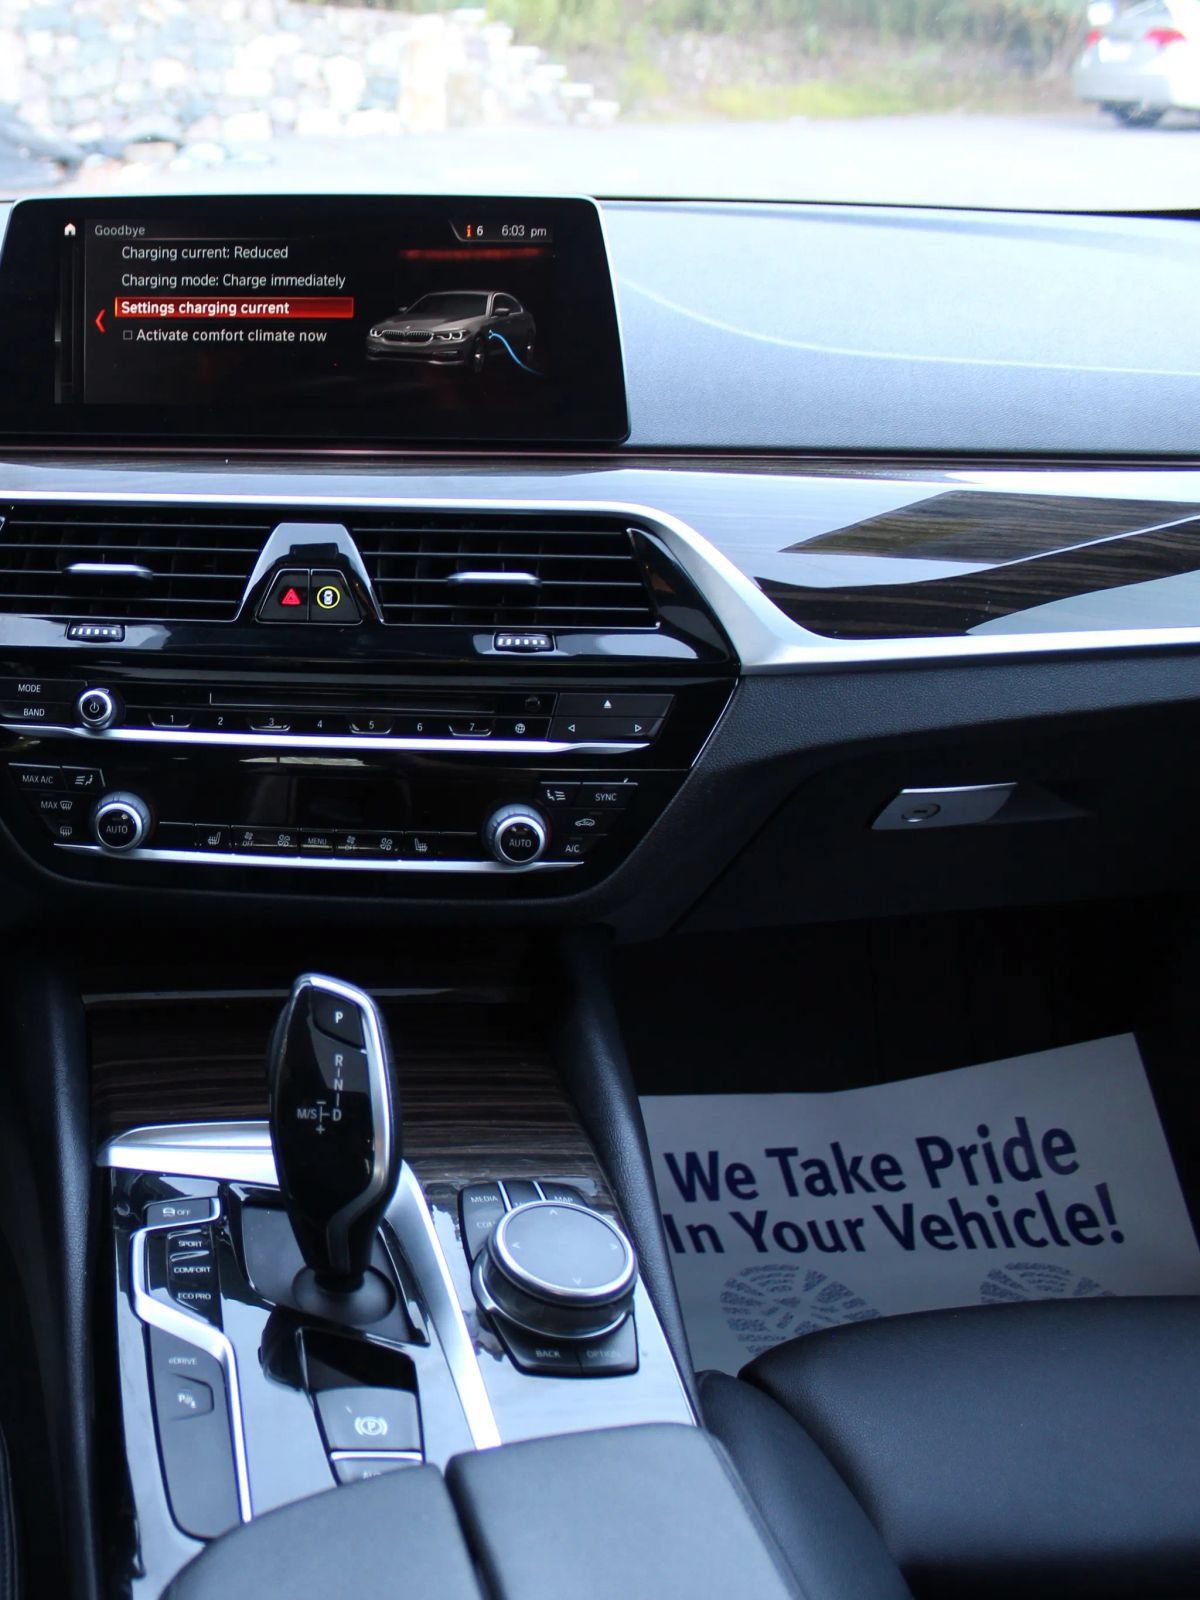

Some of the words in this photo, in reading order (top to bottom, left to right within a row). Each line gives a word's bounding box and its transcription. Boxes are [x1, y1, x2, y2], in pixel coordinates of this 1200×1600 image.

[94, 224, 146, 238] Goodbye
[476, 225, 484, 236] 6
[501, 225, 525, 236] 6:03
[530, 228, 547, 238] pm
[121, 246, 178, 260] Charging
[181, 246, 231, 259] current:
[234, 246, 289, 259] Reduced
[121, 274, 178, 288] Charging
[181, 274, 219, 287] mode:
[222, 274, 267, 288] Charge
[271, 273, 346, 288] immediately
[121, 301, 175, 316] Settings
[178, 301, 237, 316] charging
[240, 302, 290, 314] current
[136, 329, 189, 341] Activate
[192, 329, 244, 341] comfort
[248, 329, 296, 341] climate
[299, 332, 328, 341] now
[17, 683, 41, 693] MODE
[23, 707, 45, 717] BAND
[217, 716, 224, 726] 2
[269, 717, 275, 727] 3
[317, 718, 323, 728] 4
[368, 720, 375, 730] 5
[417, 722, 423, 732] 6
[469, 722, 475, 732] 7
[22, 774, 39, 784] MAX
[40, 775, 54, 785] A/C
[595, 792, 617, 802] SYNC
[40, 801, 58, 810] MAX
[105, 824, 128, 834] AUTO
[307, 837, 327, 845] MENU
[508, 838, 532, 849] AUTO
[565, 843, 580, 853] A/C
[335, 1011, 344, 1023] P
[334, 1054, 344, 1067] R
[334, 1079, 344, 1091] N
[297, 1108, 318, 1119] M/S
[333, 1109, 342, 1121] D
[663, 1149, 759, 1203] We
[765, 1141, 906, 1199] Take
[915, 1115, 1081, 1190] Pride
[470, 1195, 499, 1203] MEDIA
[662, 1213, 725, 1255] In
[729, 1209, 868, 1255] Your
[872, 1181, 1125, 1252] Vehicle!
[178, 1240, 203, 1248] SPORT
[173, 1266, 212, 1274] COMFORT
[177, 1292, 195, 1300] ECO
[195, 1292, 212, 1300] PRO
[535, 1350, 560, 1358] BACK
